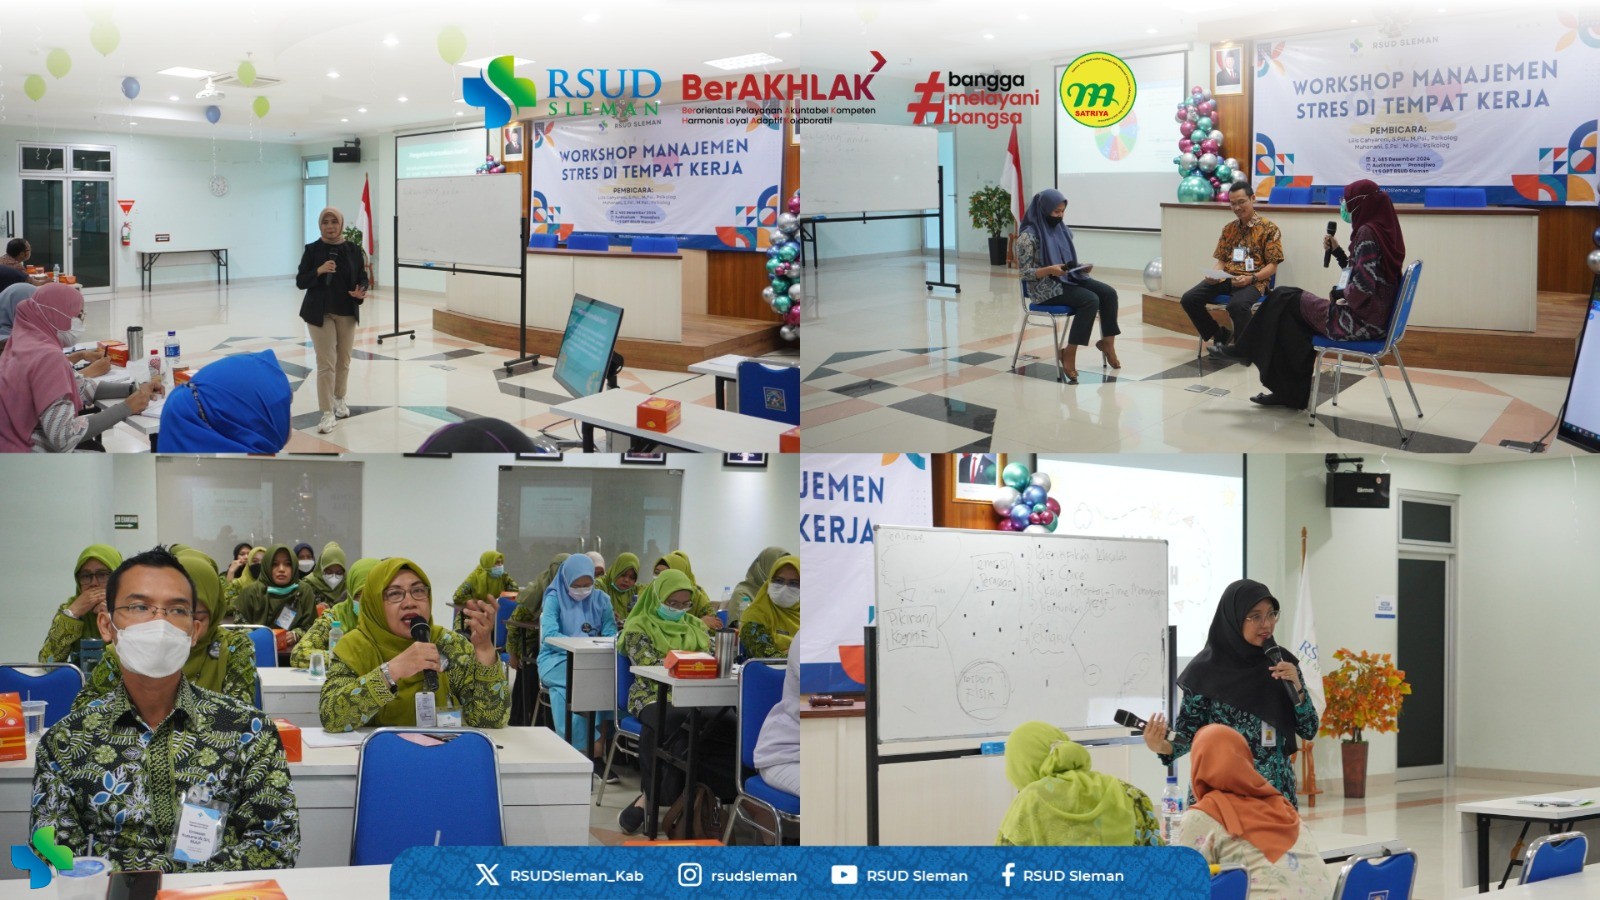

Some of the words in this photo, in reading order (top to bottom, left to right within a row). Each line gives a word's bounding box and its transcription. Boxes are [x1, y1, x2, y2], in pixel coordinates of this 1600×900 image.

[1372, 41, 1397, 49] RSUD
[1400, 36, 1439, 47] SLEMAN
[1293, 72, 1404, 95] WORKSHOP
[1412, 59, 1558, 87] MANAJEMEN
[1297, 100, 1349, 119] STRES
[1356, 99, 1376, 116] DI
[1383, 93, 1469, 114] TEMPAT
[1477, 88, 1550, 110] KERJA
[634, 119, 662, 127] SLEMAN
[1370, 125, 1427, 135] PEMBICARA:
[560, 146, 637, 163] WORKSHOP
[643, 138, 749, 158] MANAJEMEN
[562, 167, 598, 181] STRES
[603, 167, 617, 179] DI
[622, 162, 683, 178] TEMPAT
[690, 160, 743, 176] KERJA
[800, 513, 874, 545] KERJA
